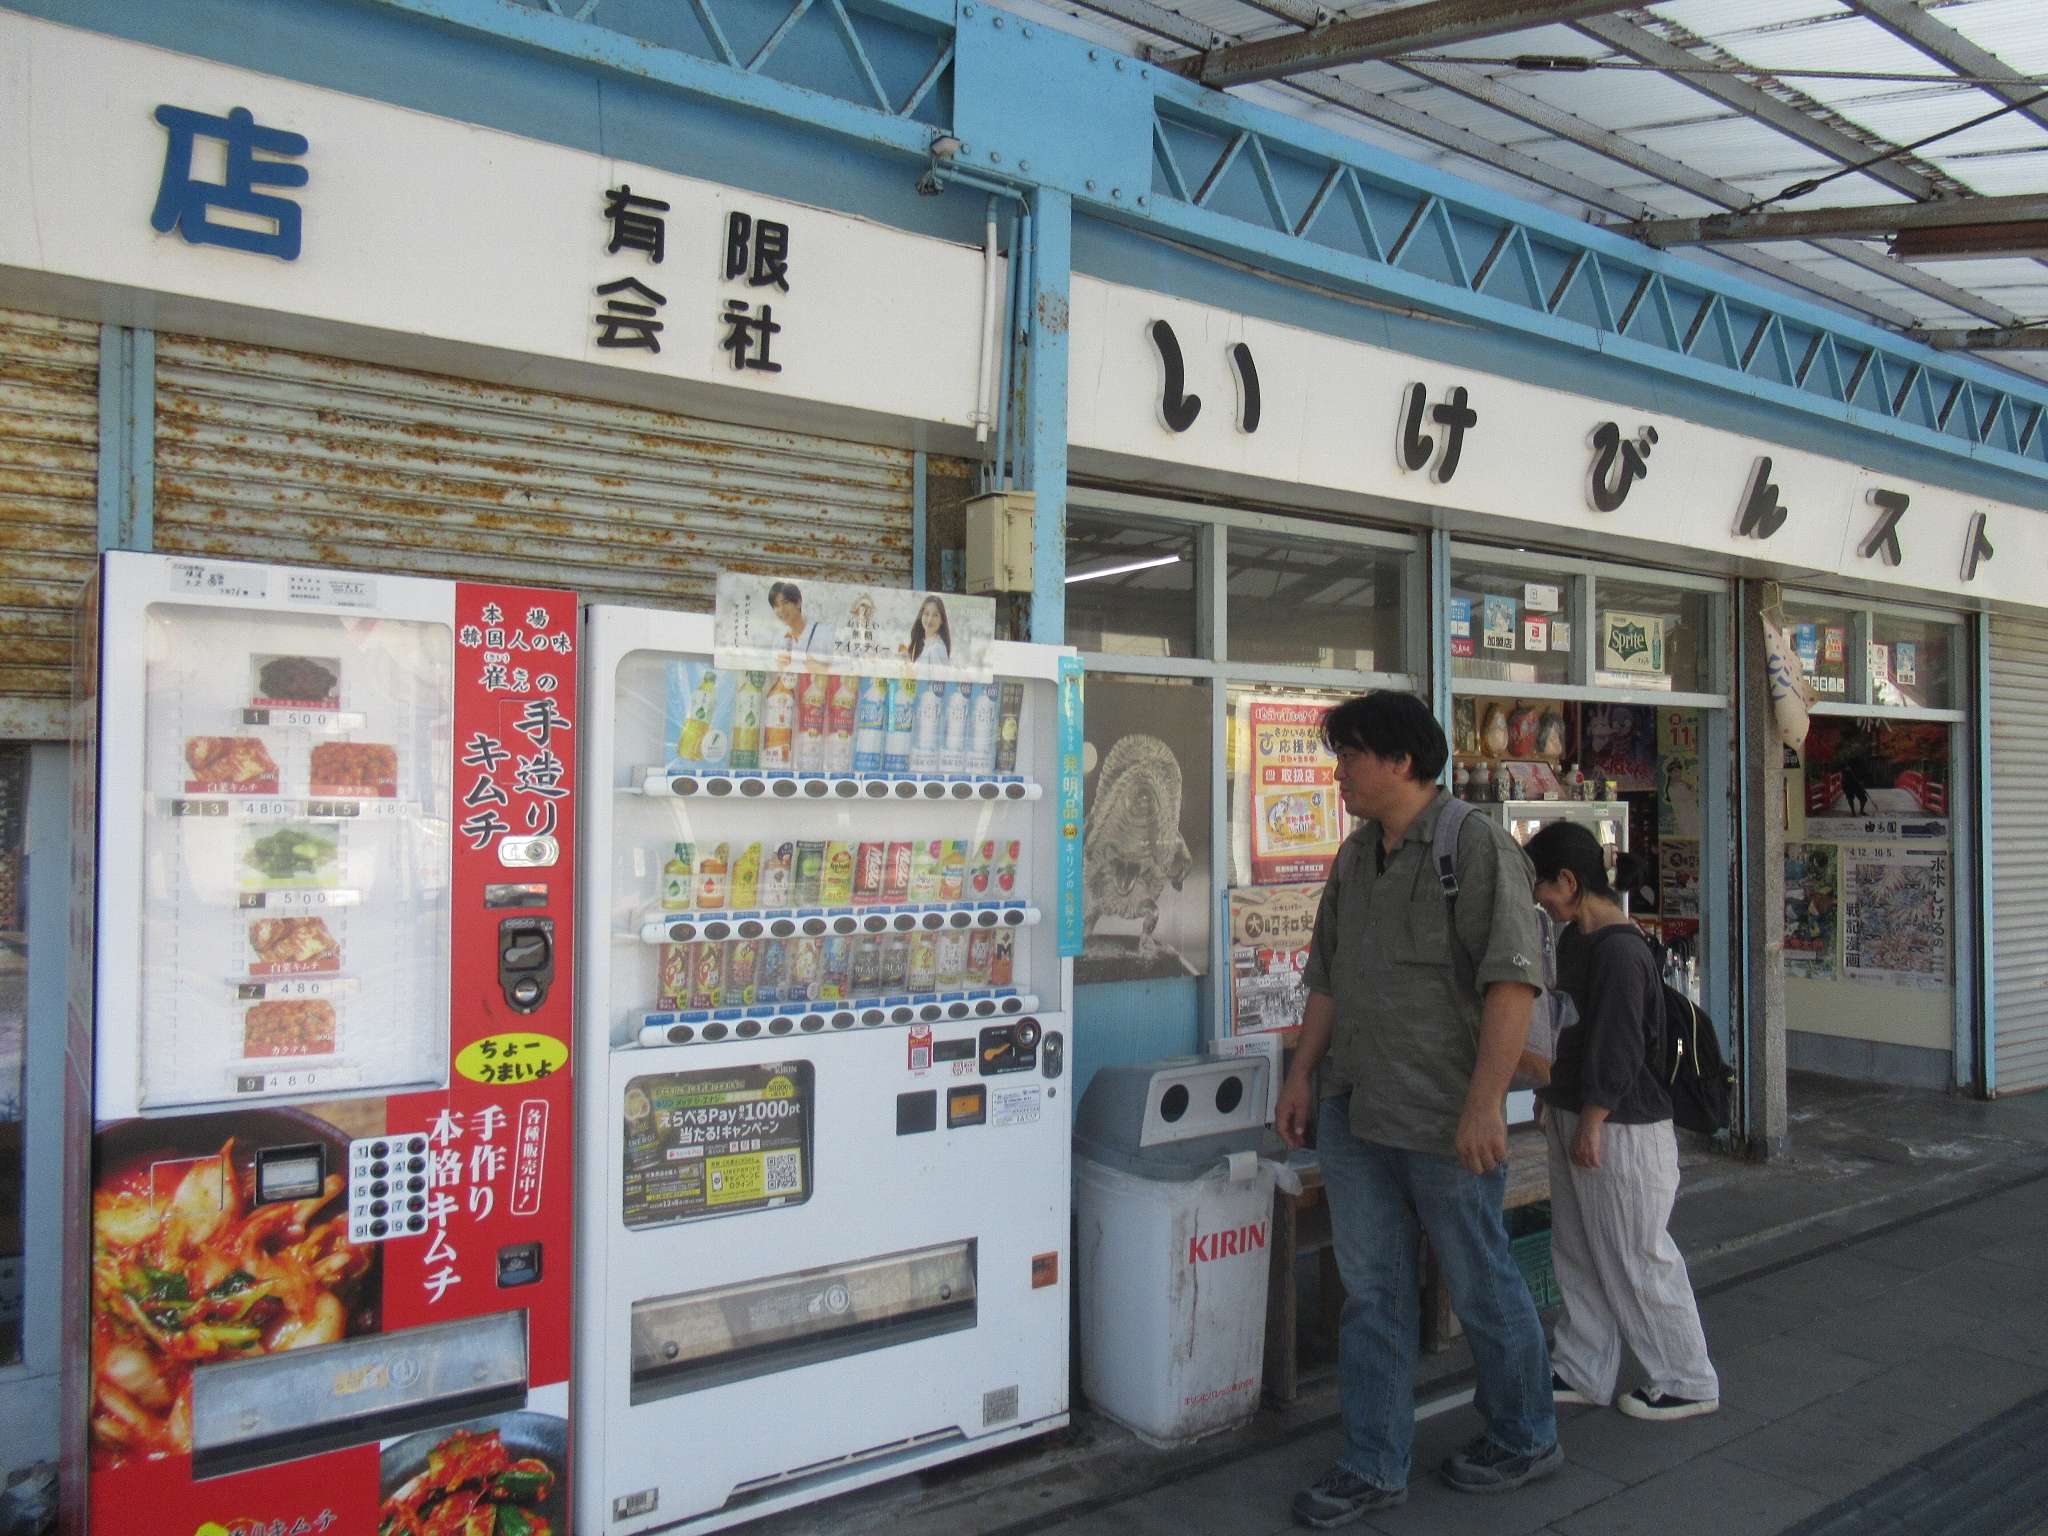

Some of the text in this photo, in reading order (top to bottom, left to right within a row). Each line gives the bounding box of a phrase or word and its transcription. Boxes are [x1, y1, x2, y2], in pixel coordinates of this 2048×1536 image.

[151, 104, 309, 260] 店
[482, 603, 550, 628] 本場
[460, 625, 572, 655] 韓国人の味
[1612, 630, 1645, 654] Sprite
[288, 713, 327, 725] 500
[513, 697, 571, 837] 手造り
[1281, 768, 1316, 784] 取扱店
[460, 732, 511, 849] キムチ
[246, 803, 282, 815] 480
[284, 893, 326, 905] 500
[281, 983, 320, 994] 480
[480, 1040, 540, 1058] ちょー
[270, 1073, 316, 1087] 480
[480, 1060, 552, 1082] うまいよ
[470, 1104, 507, 1222] 手作り
[423, 1108, 465, 1305] 本格キムチ
[1188, 1221, 1267, 1265] KIRIN
